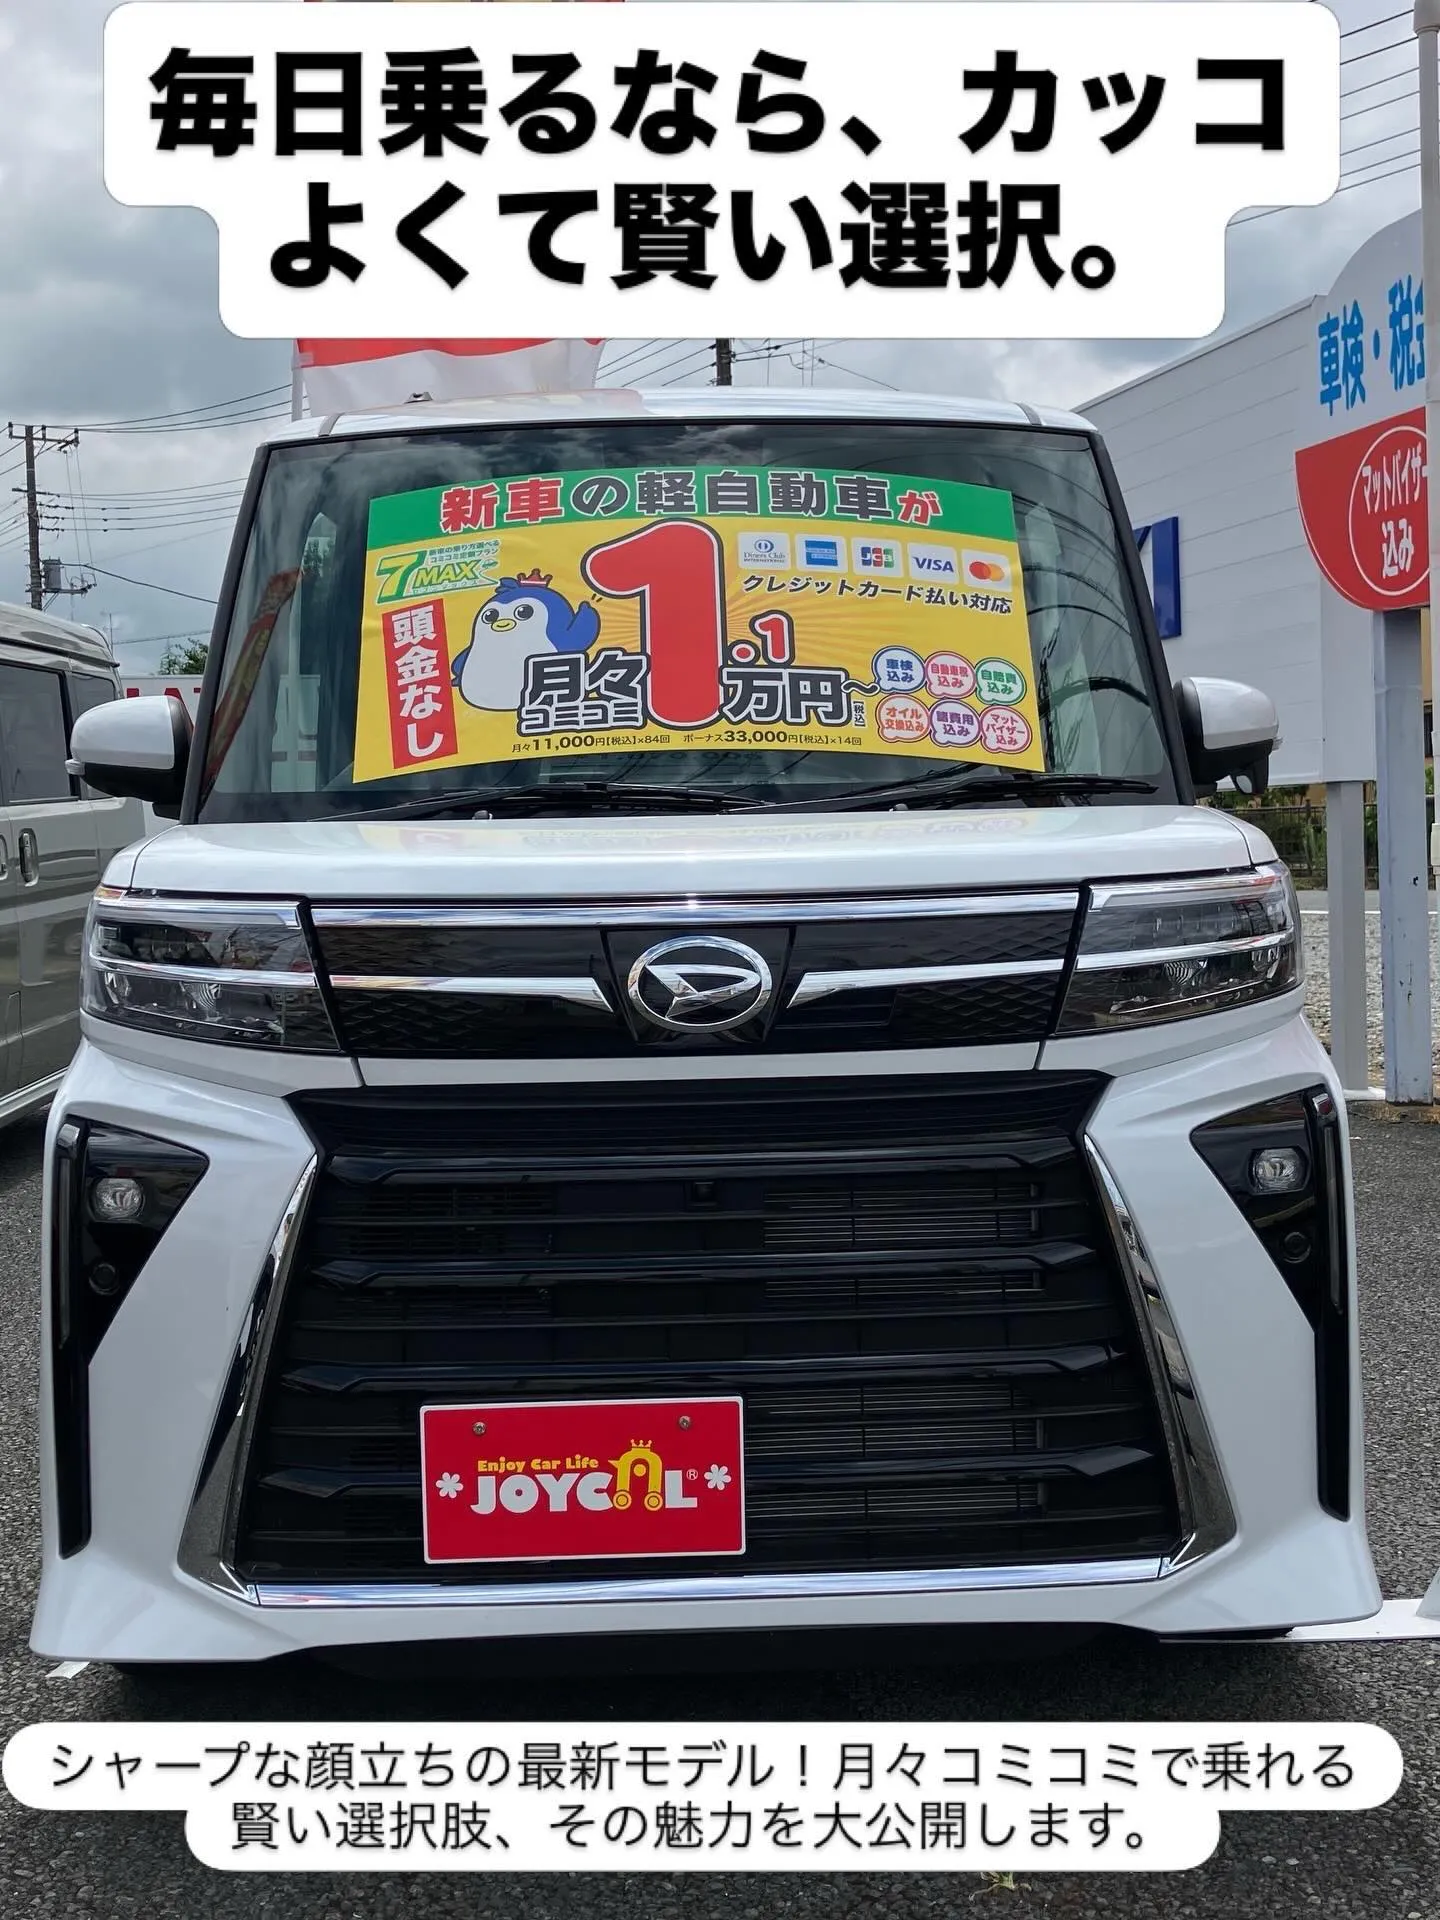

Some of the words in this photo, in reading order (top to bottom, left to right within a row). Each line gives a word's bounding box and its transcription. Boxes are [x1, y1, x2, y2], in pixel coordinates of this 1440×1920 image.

[440, 470, 942, 533] 新車の軽自動車が
[1381, 517, 1415, 579] 込み
[861, 546, 894, 568] JCB
[912, 556, 954, 573] VISA
[743, 574, 1013, 615] クレジットカード払い対応
[886, 658, 913, 672] 車検
[392, 604, 445, 758] 頭金なし
[525, 650, 648, 704] 月々
[887, 670, 914, 683] 込み
[938, 675, 964, 688] 込み
[987, 682, 1014, 695] 込み
[519, 701, 647, 734] コミコミ
[885, 707, 922, 720] オイル
[990, 713, 1019, 725] マット
[943, 724, 971, 737] 込み
[986, 722, 1025, 736] バイザー
[996, 734, 1018, 746] 込み
[478, 1456, 526, 1473] Enjoy
[530, 1457, 561, 1470] Car
[566, 1454, 599, 1470] Life
